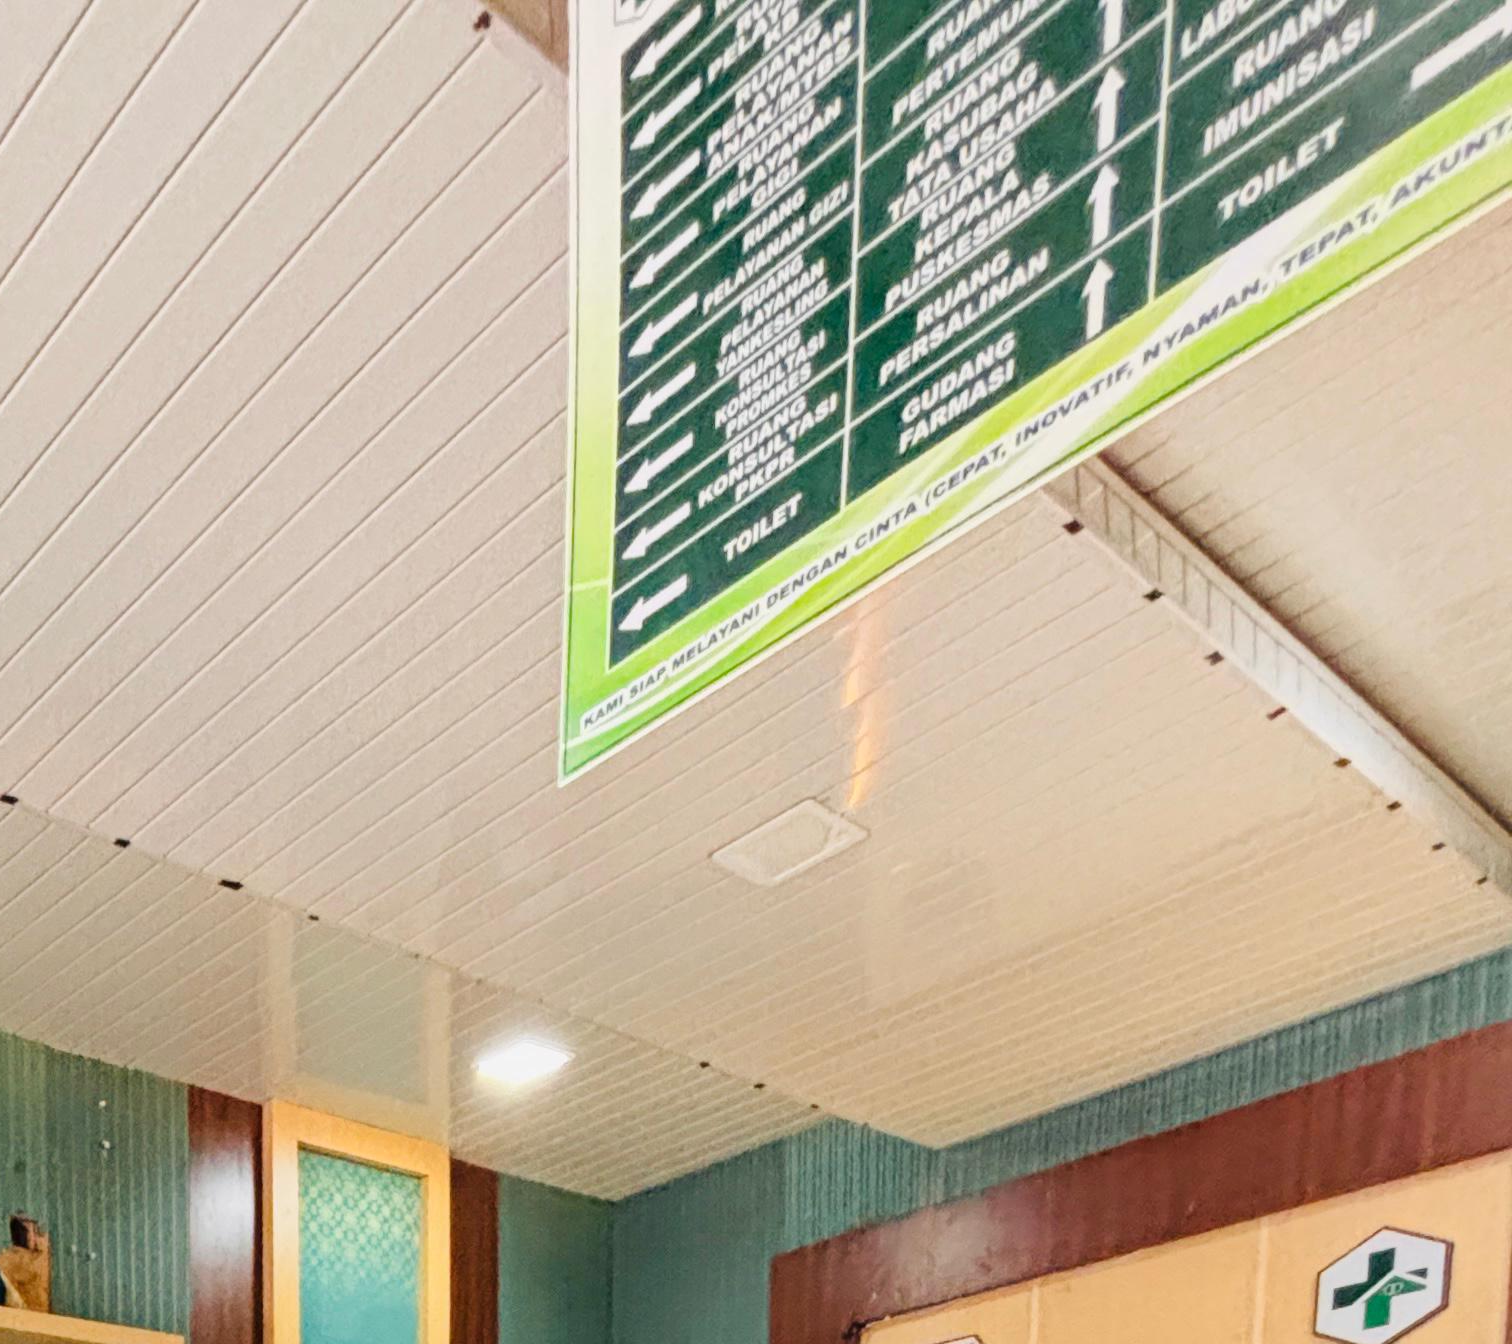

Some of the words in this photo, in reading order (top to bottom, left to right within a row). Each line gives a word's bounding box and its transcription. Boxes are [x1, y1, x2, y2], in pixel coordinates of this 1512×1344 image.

[707, 11, 852, 155] PELAYANAN
[707, 37, 853, 179] ANAK/MTBS
[736, 19, 822, 107] RUANG
[924, 47, 1020, 141] RUANG
[1202, 7, 1376, 157] IMUNISASI
[713, 96, 842, 222] PELAYANAN
[738, 97, 815, 177] RUANG
[888, 161, 951, 223] TATA
[959, 77, 1056, 168] USAHA
[906, 61, 1039, 184] KASUBAG
[1217, 116, 1345, 221] TOILET
[743, 187, 806, 254] RUANG
[751, 157, 798, 209] GIGI
[914, 168, 1020, 263] KEPALA
[920, 142, 1016, 231] RUANG
[703, 217, 805, 315] PELAYANAN
[809, 180, 849, 226] GIZI
[741, 254, 803, 317] RUANG
[885, 172, 1050, 313] PUSKESMAS
[716, 278, 829, 377] YANKESLING
[720, 257, 827, 354] PELAYANAN
[879, 248, 1049, 386] PERSALINAN
[916, 249, 1010, 333] RUANG
[714, 330, 826, 429] KONSULTASI
[725, 361, 811, 440] PROMKES
[739, 329, 801, 390] RUANG
[899, 359, 1016, 454] FARMASI
[901, 331, 1016, 424] GUDANG
[583, 695, 624, 728] KAMI
[630, 667, 667, 700] SIAP
[672, 607, 760, 671] MELAYANI
[766, 549, 848, 609] DENGAN
[854, 504, 918, 551] CINTA
[1391, 114, 1512, 209] AKUNT
[698, 392, 838, 508] KONSULTASI
[728, 395, 807, 466] RUANG
[735, 446, 795, 502] PKPR
[724, 492, 802, 562] TOILET
